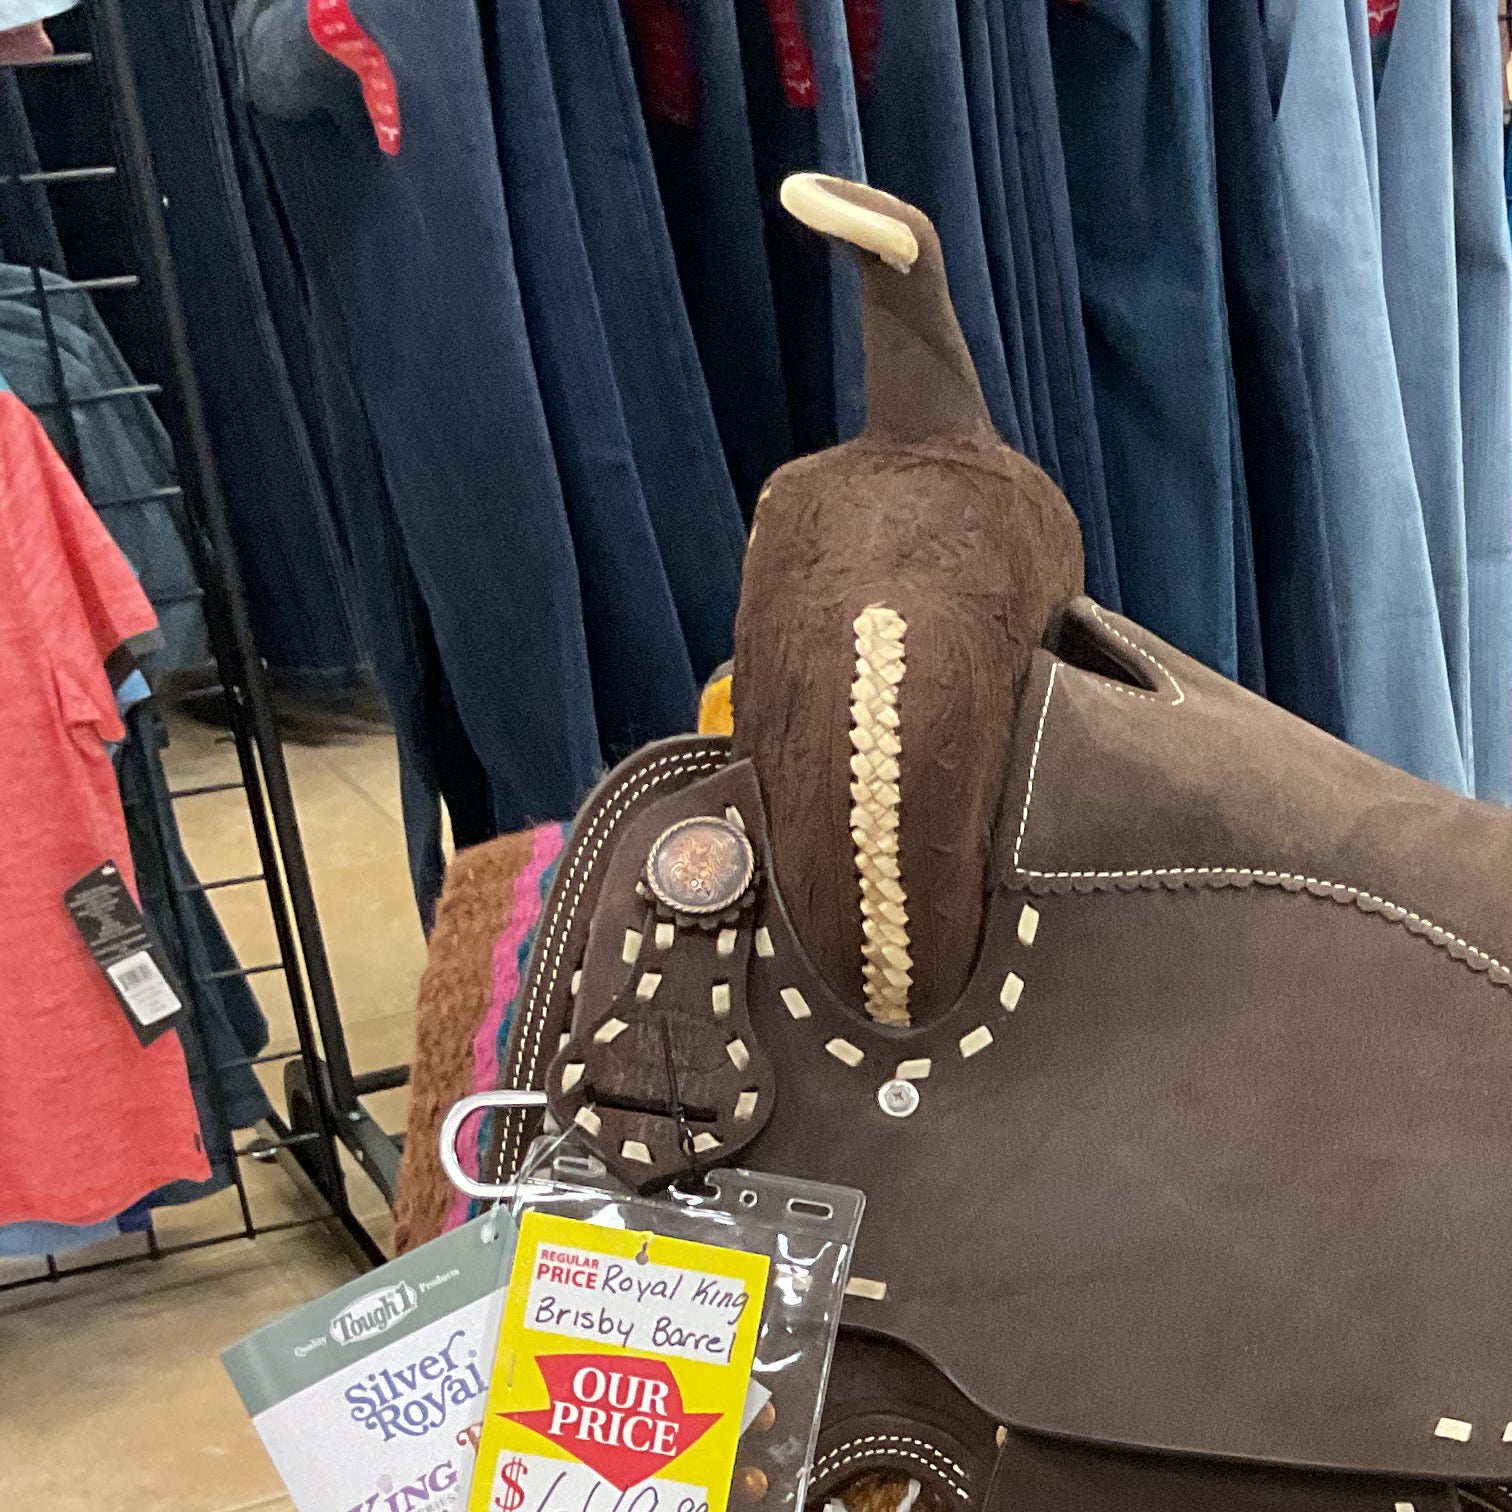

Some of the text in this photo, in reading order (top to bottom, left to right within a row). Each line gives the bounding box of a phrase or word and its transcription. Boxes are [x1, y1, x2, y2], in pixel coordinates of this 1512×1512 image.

[536, 1263, 598, 1290] PRICE
[540, 1249, 600, 1270] REGULAR
[294, 1336, 327, 1358] Quality
[418, 1268, 460, 1293] Products
[601, 1264, 750, 1326] Royal King
[534, 1296, 737, 1364] Brisby Barrel
[344, 1330, 466, 1422] Silver
[365, 1362, 489, 1442] Royal
[572, 1366, 669, 1416] OUR
[547, 1400, 680, 1457] PRICE
